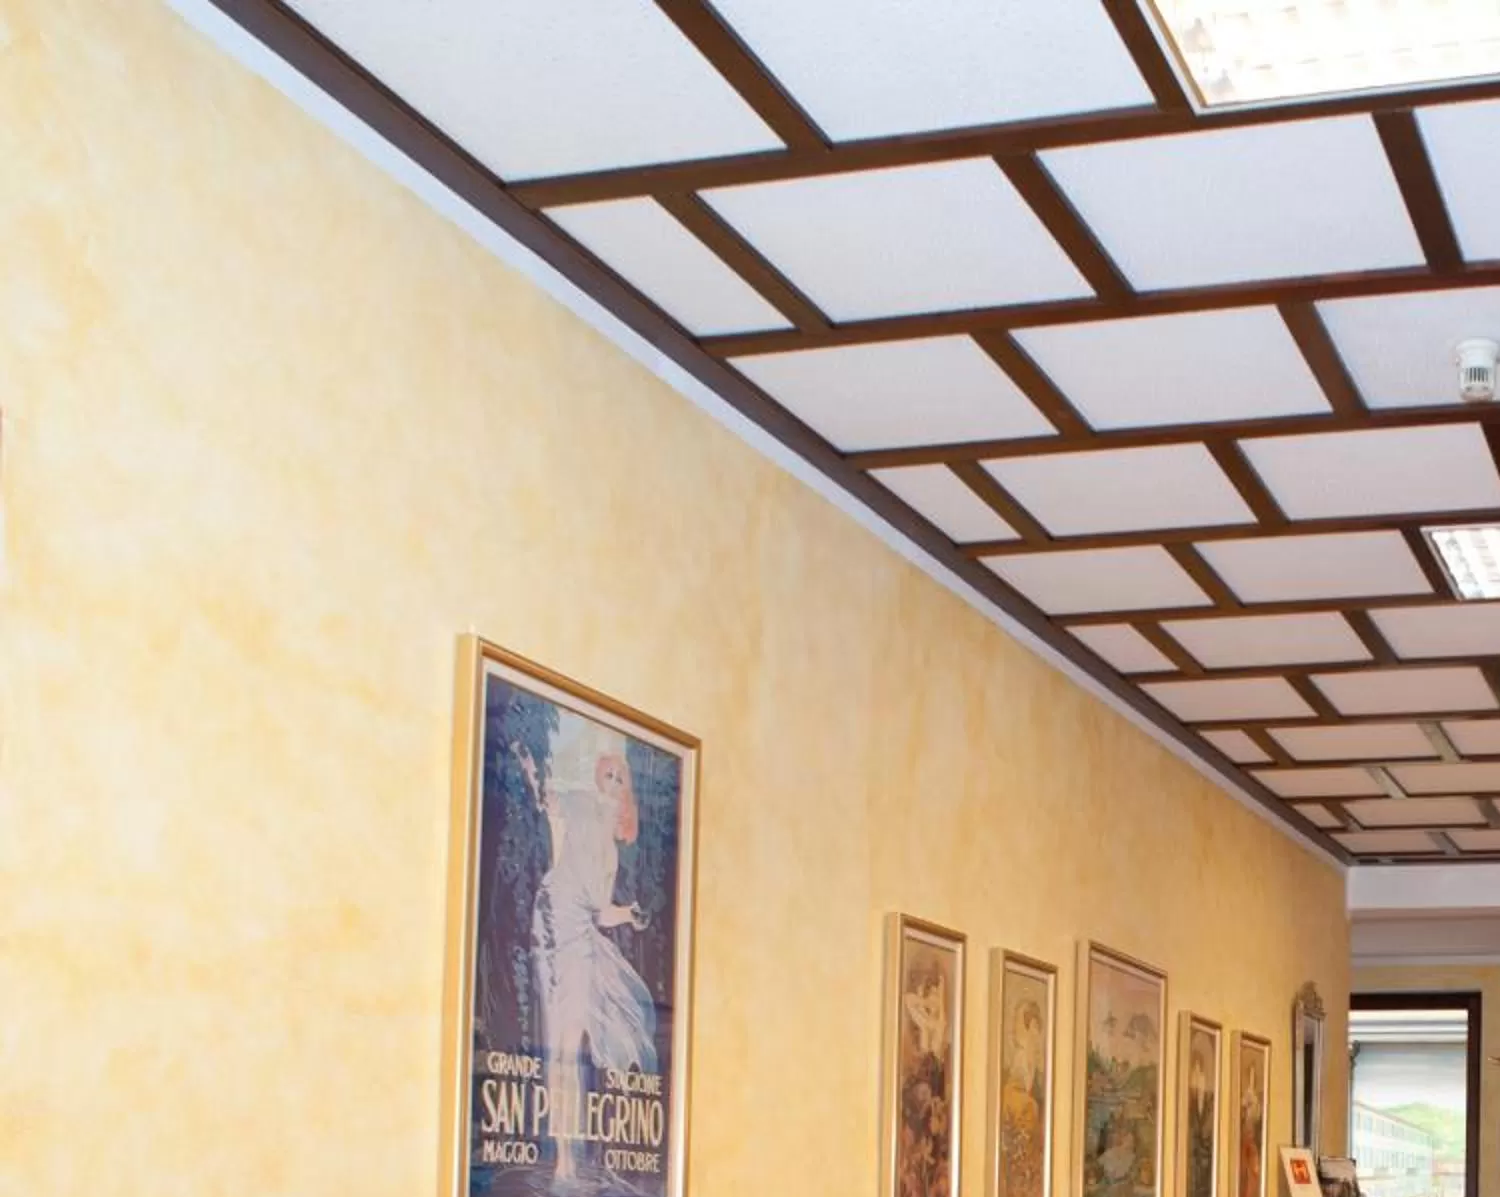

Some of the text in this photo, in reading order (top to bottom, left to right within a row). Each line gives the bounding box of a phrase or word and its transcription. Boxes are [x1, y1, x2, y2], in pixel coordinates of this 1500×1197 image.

[488, 1052, 542, 1078] GRANDE
[482, 1080, 525, 1134] SAN
[483, 1140, 660, 1172] MAGGIO OTTOBRE
